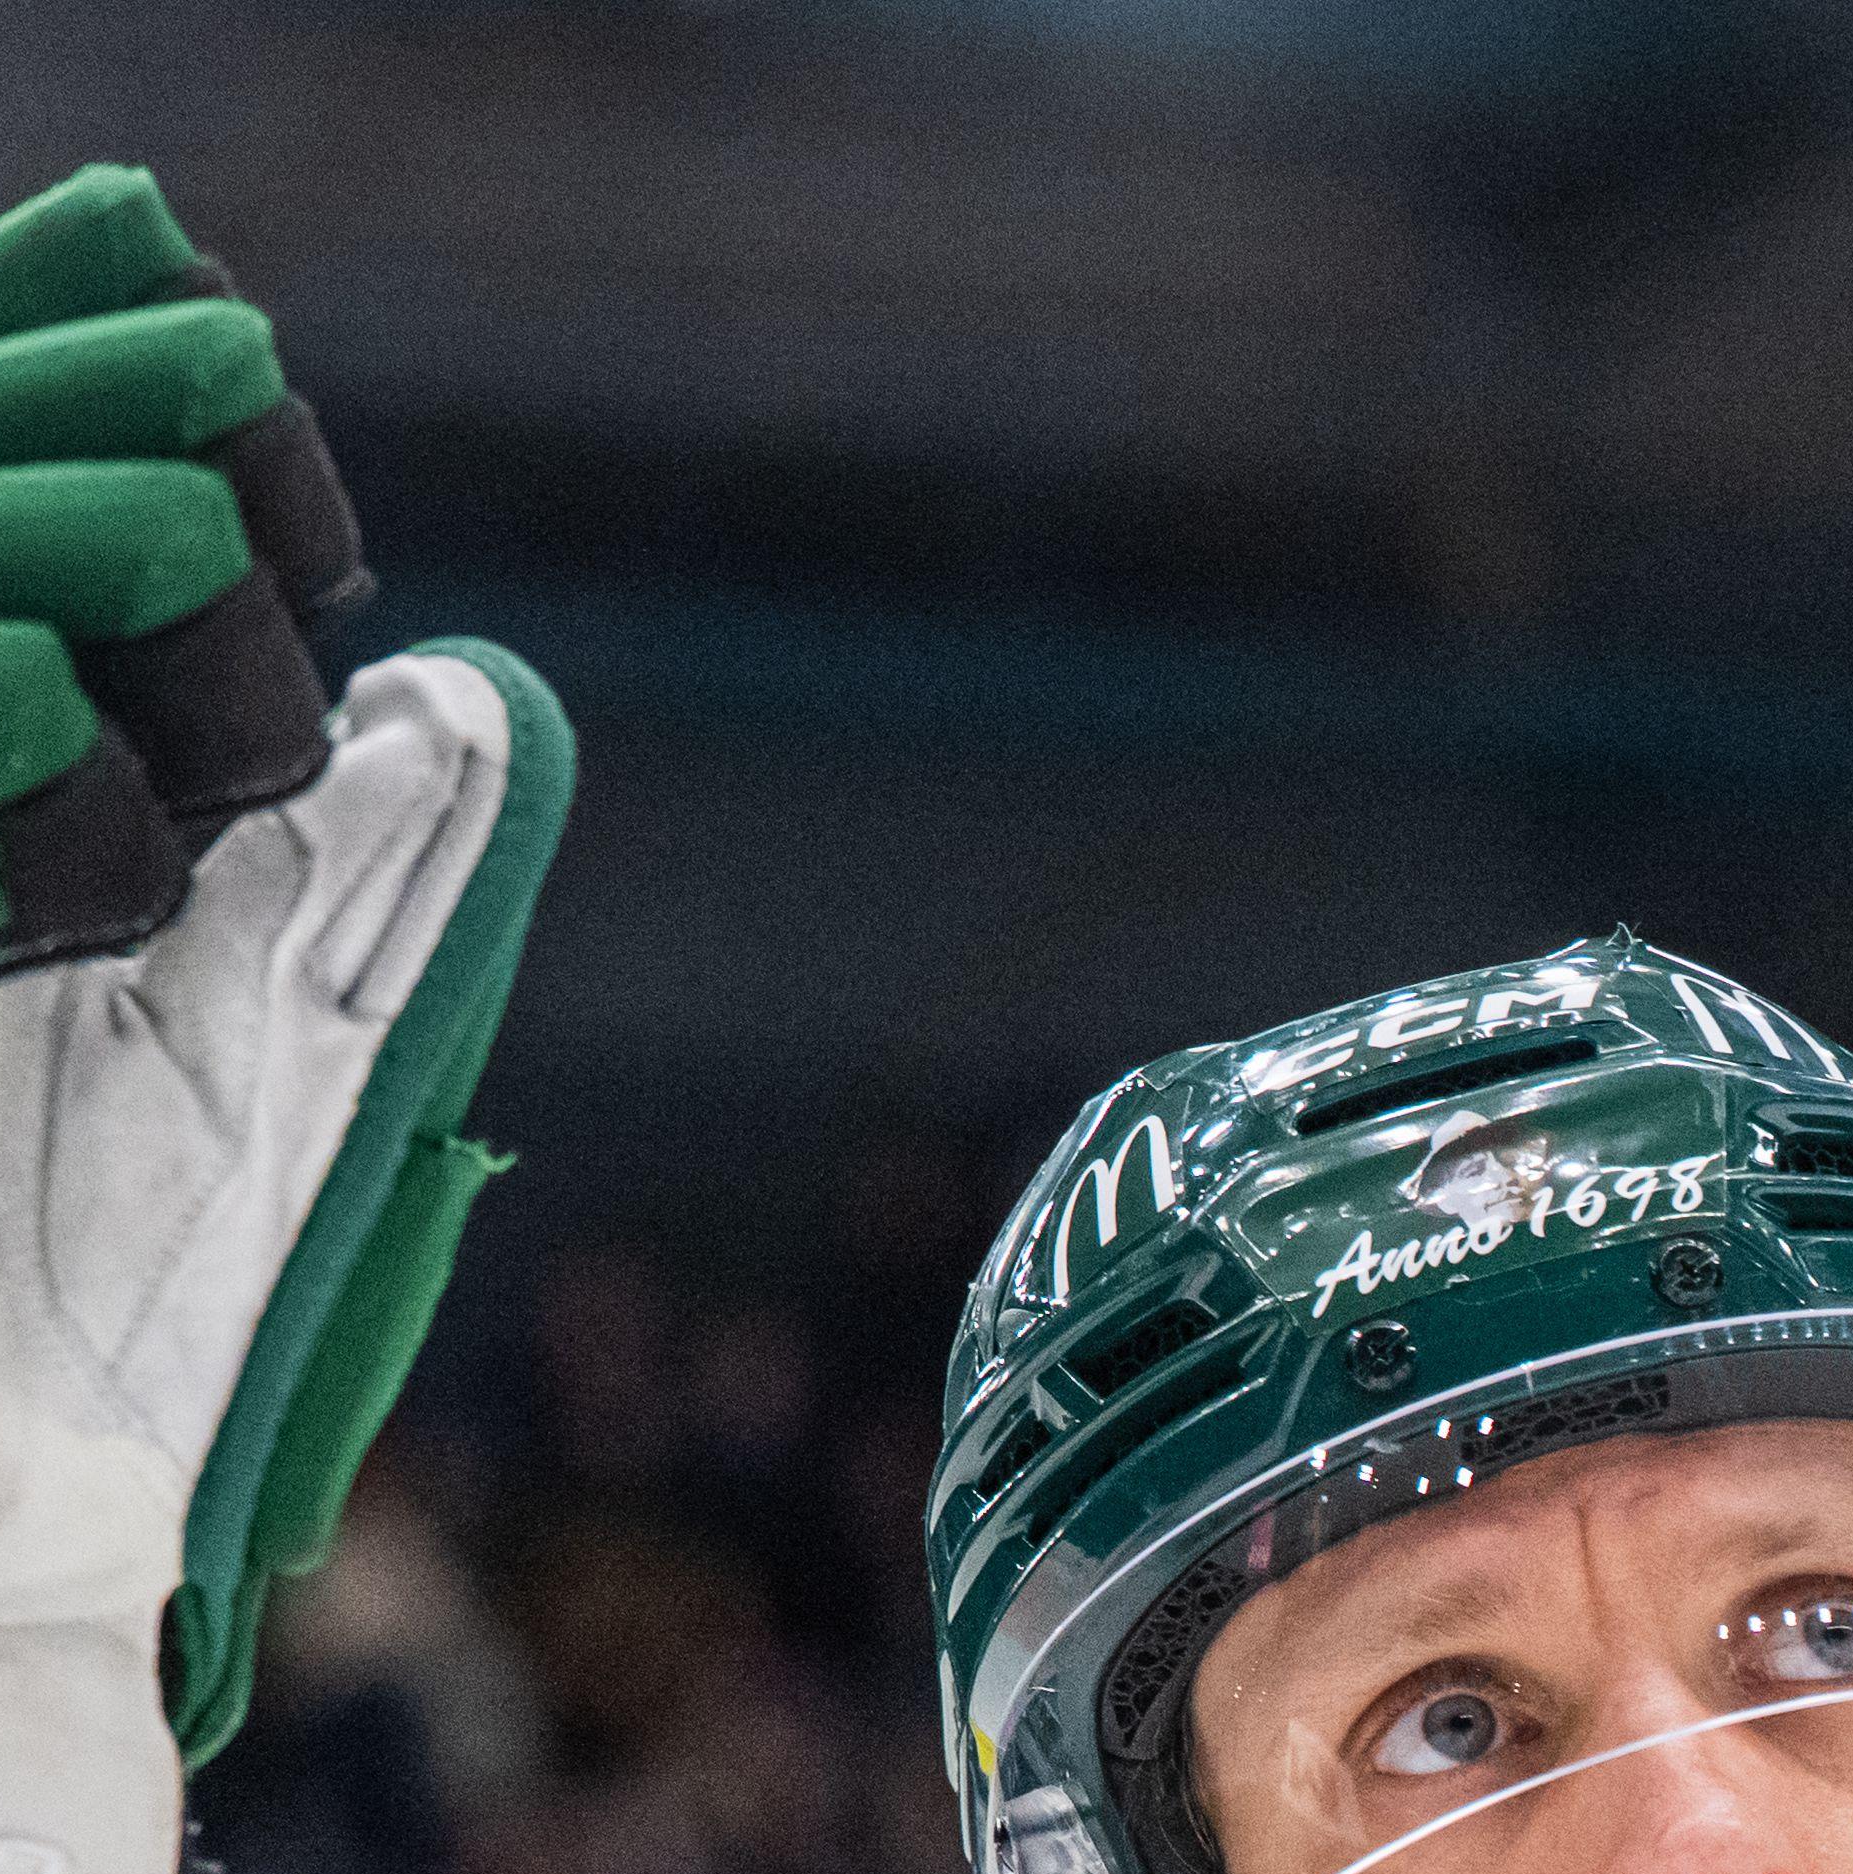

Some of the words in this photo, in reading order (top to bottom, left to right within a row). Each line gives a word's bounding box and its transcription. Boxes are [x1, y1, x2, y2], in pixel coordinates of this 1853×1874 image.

[1240, 981, 1602, 1098] CCM
[1312, 1215, 1513, 1319] Anno
[1529, 1156, 1707, 1237] 1698
